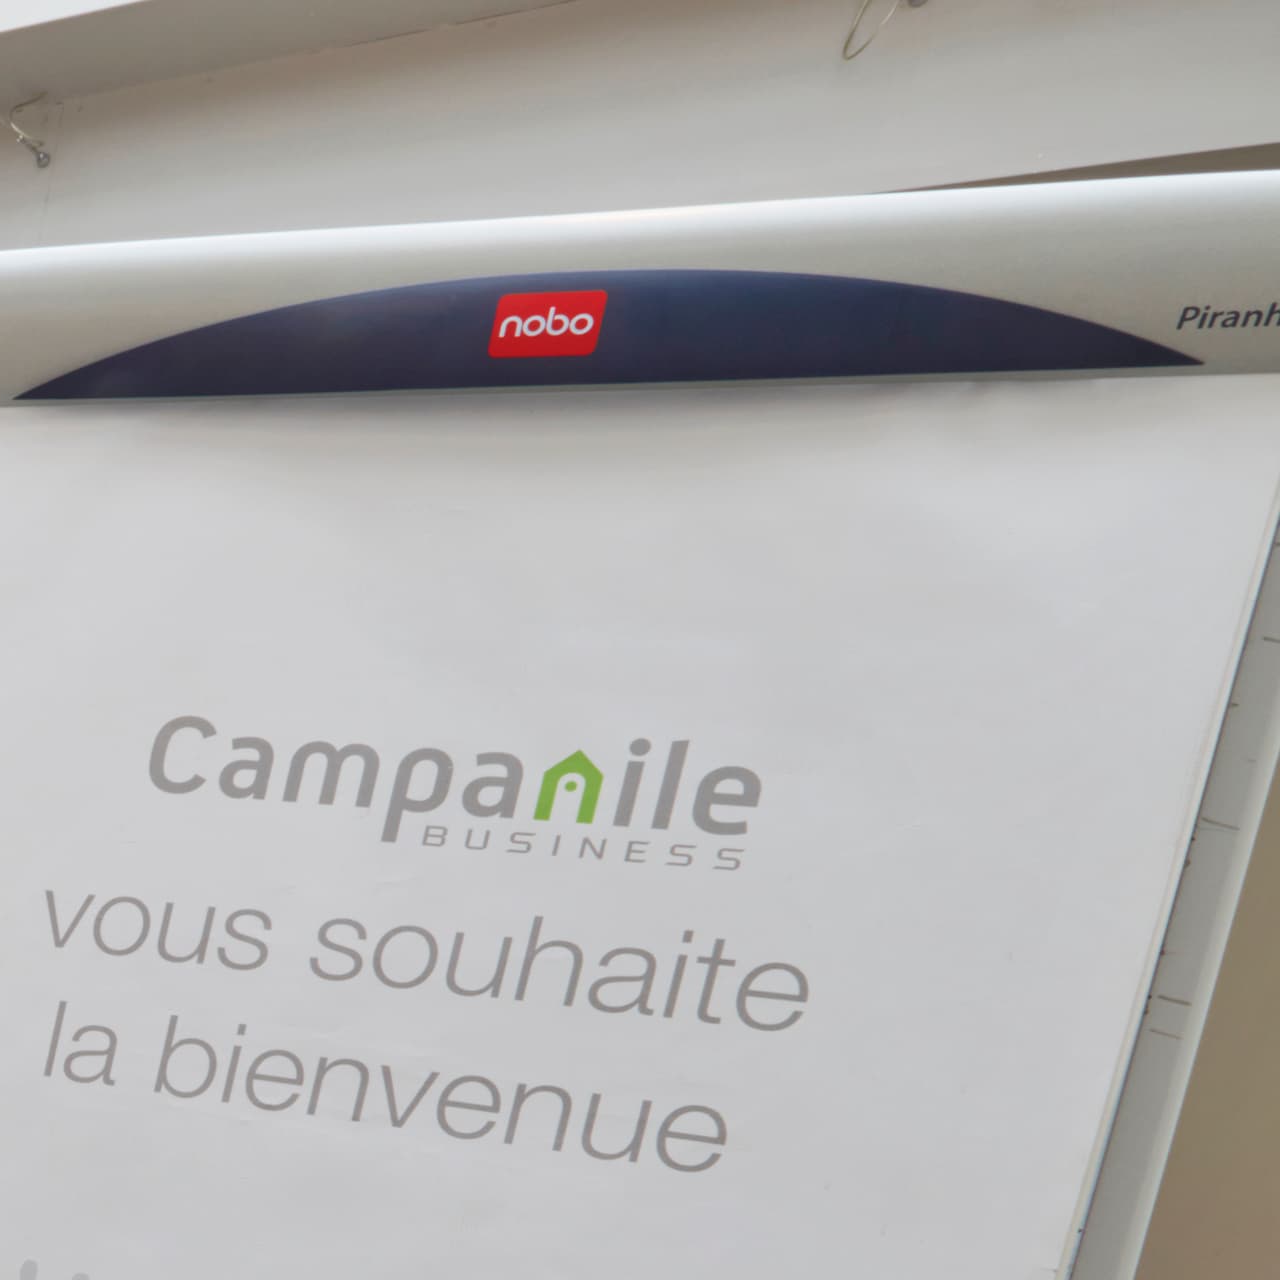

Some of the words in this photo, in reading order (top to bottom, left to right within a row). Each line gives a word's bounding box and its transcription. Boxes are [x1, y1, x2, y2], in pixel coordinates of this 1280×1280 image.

[498, 306, 594, 338] nobo
[1176, 302, 1280, 330] Piranh
[148, 715, 762, 843] Campanile
[421, 825, 746, 871] BUSINESS
[44, 889, 273, 971] vous
[308, 915, 810, 1032] souhaite
[43, 1000, 119, 1087] la
[152, 1014, 729, 1174] bienvenue
